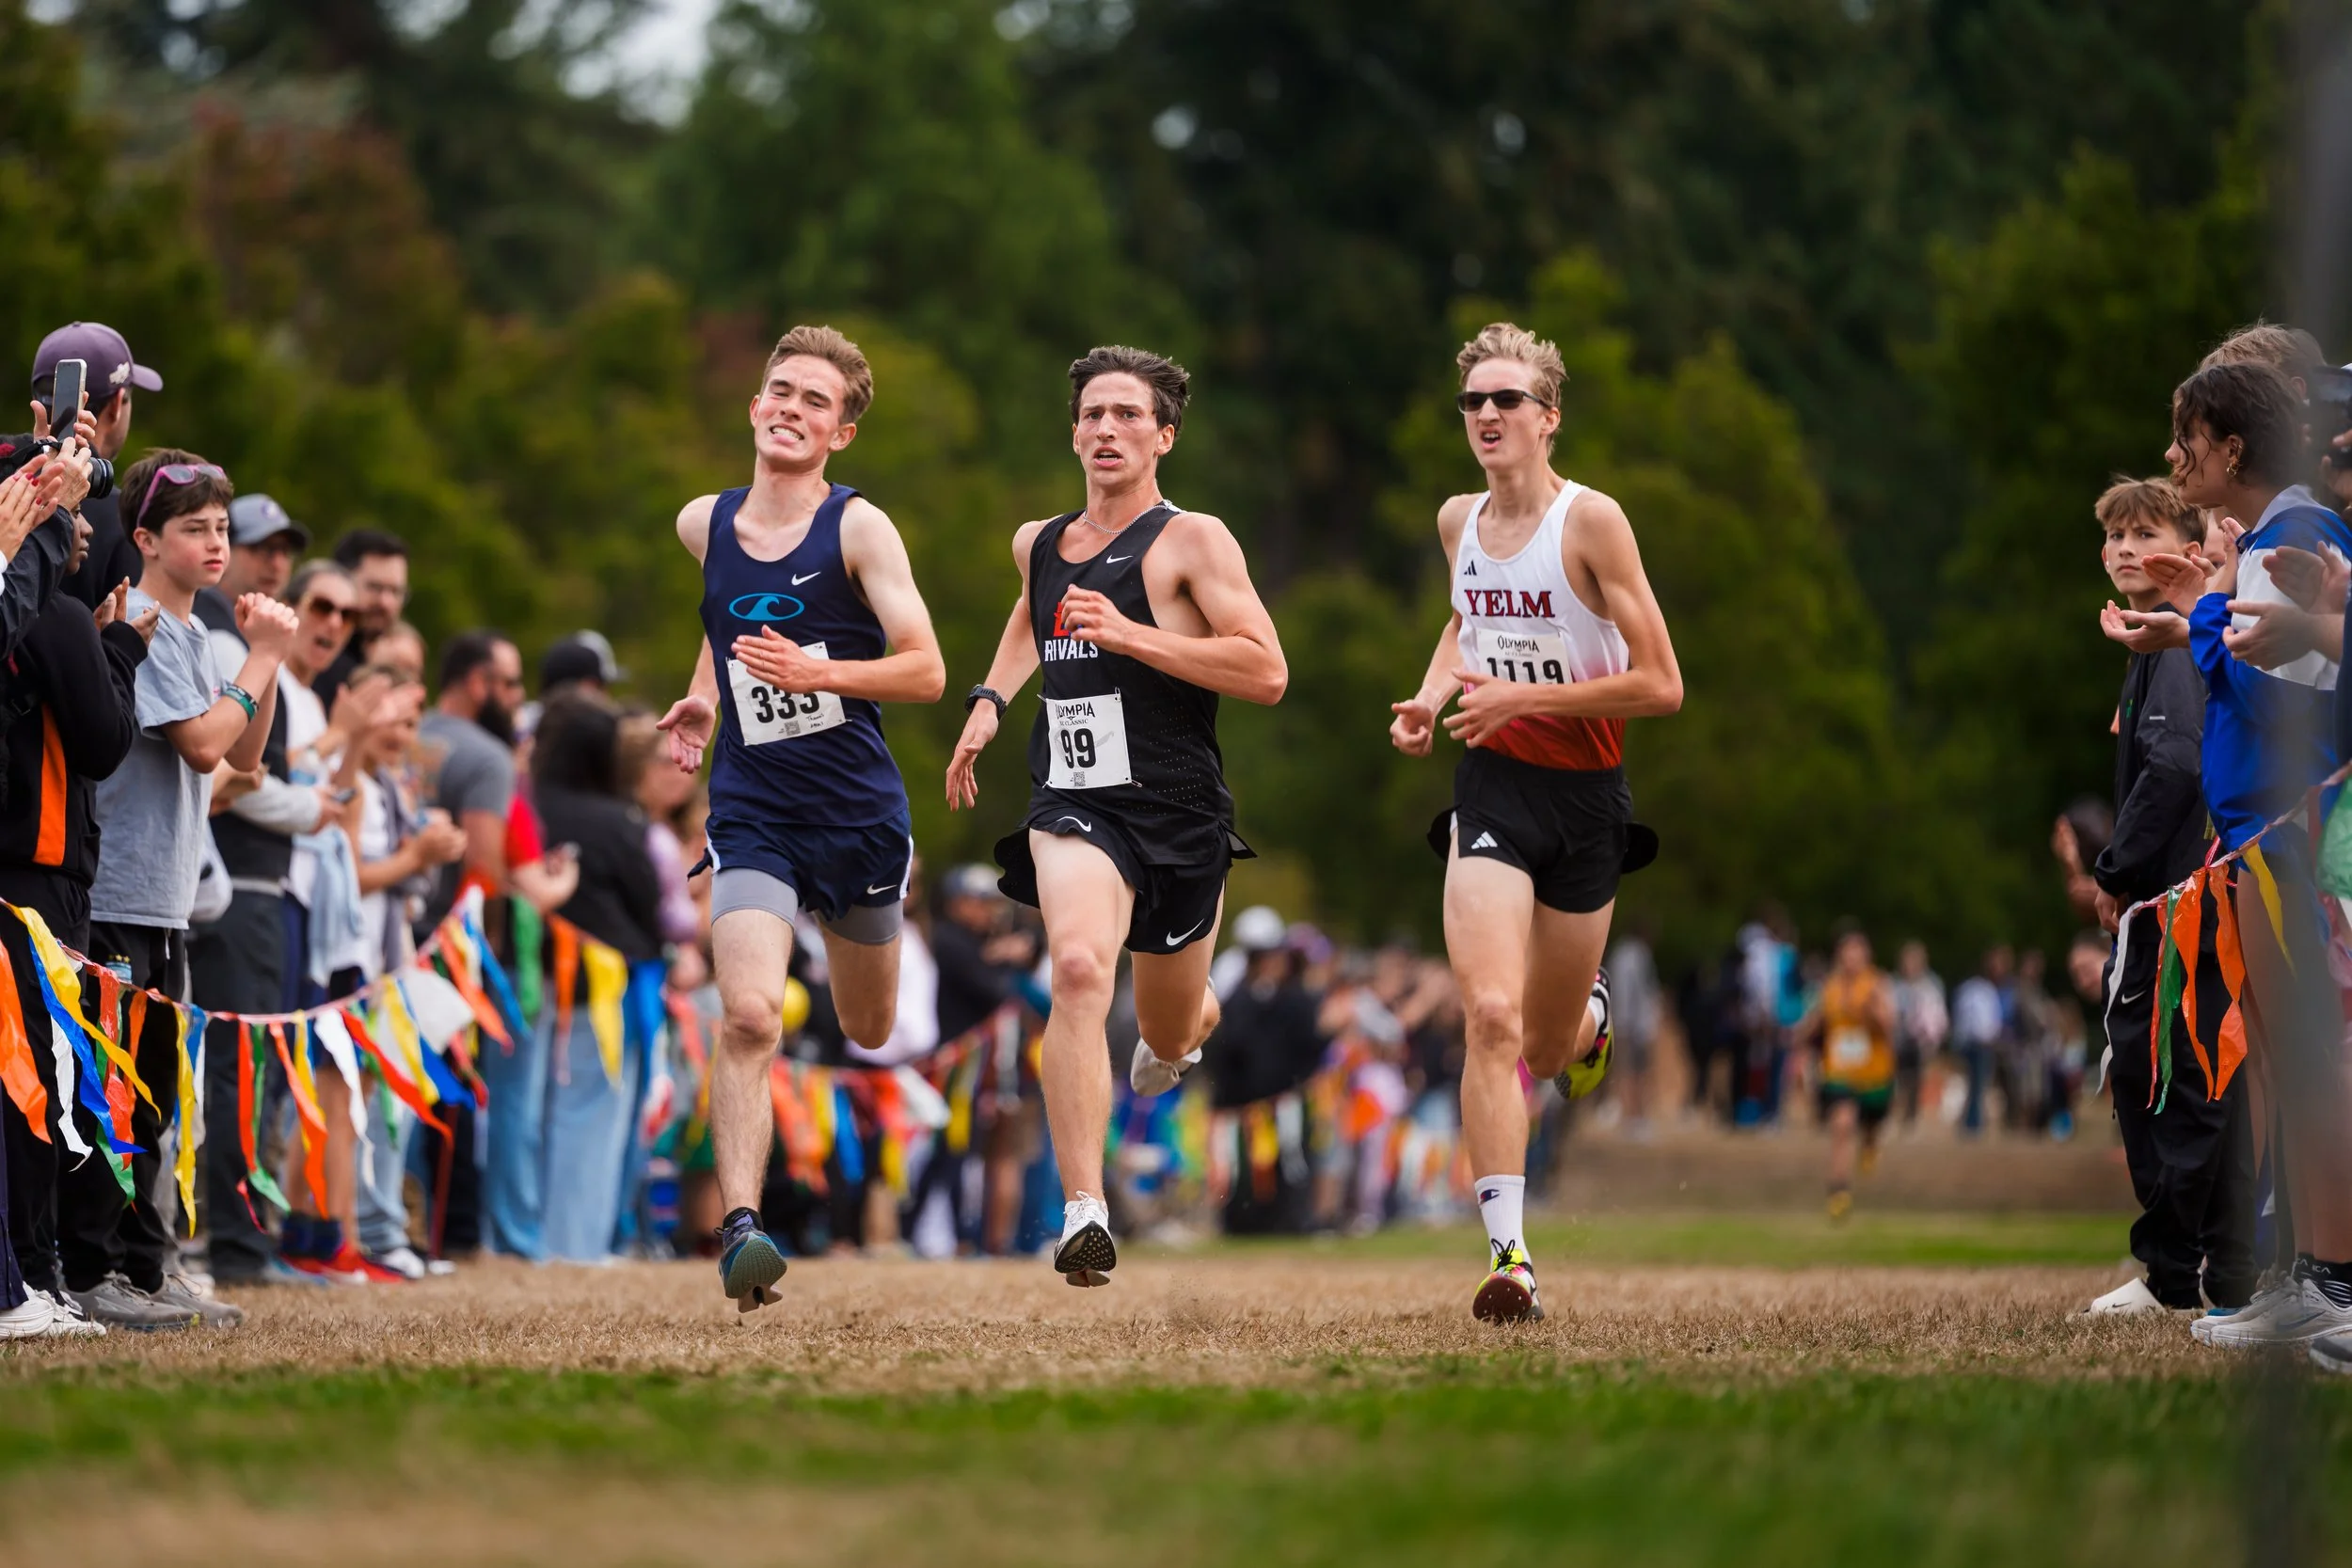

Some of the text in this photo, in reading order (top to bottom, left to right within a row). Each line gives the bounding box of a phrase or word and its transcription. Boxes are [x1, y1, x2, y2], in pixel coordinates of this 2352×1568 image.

[1464, 589, 1555, 618] YELM
[1044, 639, 1098, 661] RIVALS
[1498, 635, 1540, 653] OLYMPIA
[1060, 727, 1096, 769] 99
